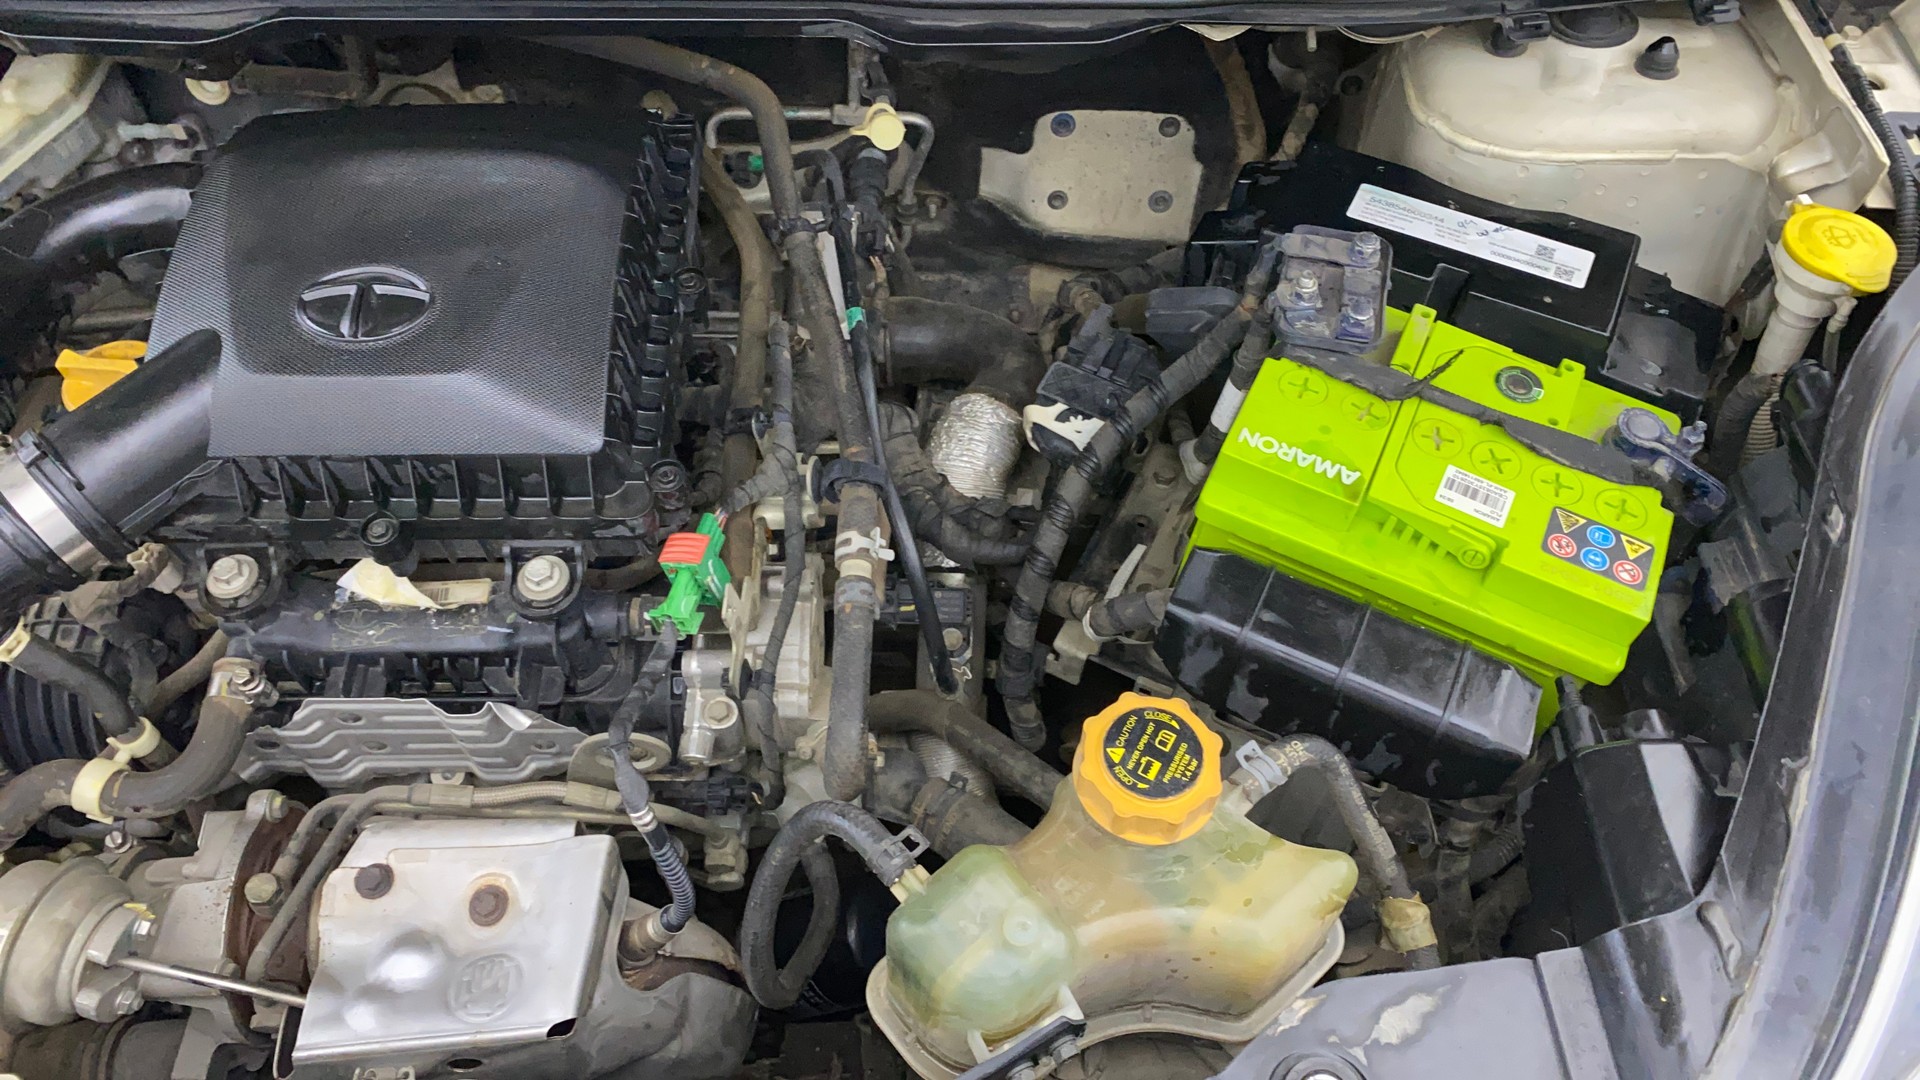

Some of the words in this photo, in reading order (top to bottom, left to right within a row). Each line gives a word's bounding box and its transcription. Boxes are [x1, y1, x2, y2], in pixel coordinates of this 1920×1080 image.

[1237, 427, 1362, 485] AMARON
[1115, 714, 1139, 747] CAUTION
[1143, 710, 1173, 723] CLOSE
[1126, 749, 1141, 771] NEVER
[1136, 734, 1149, 751] OPEN
[1146, 721, 1156, 737] HOT
[1112, 765, 1134, 786] OPEN
[1162, 742, 1189, 784] PRESSURISED
[1173, 753, 1192, 779] SYSTEM
[1187, 758, 1199, 772] bar
